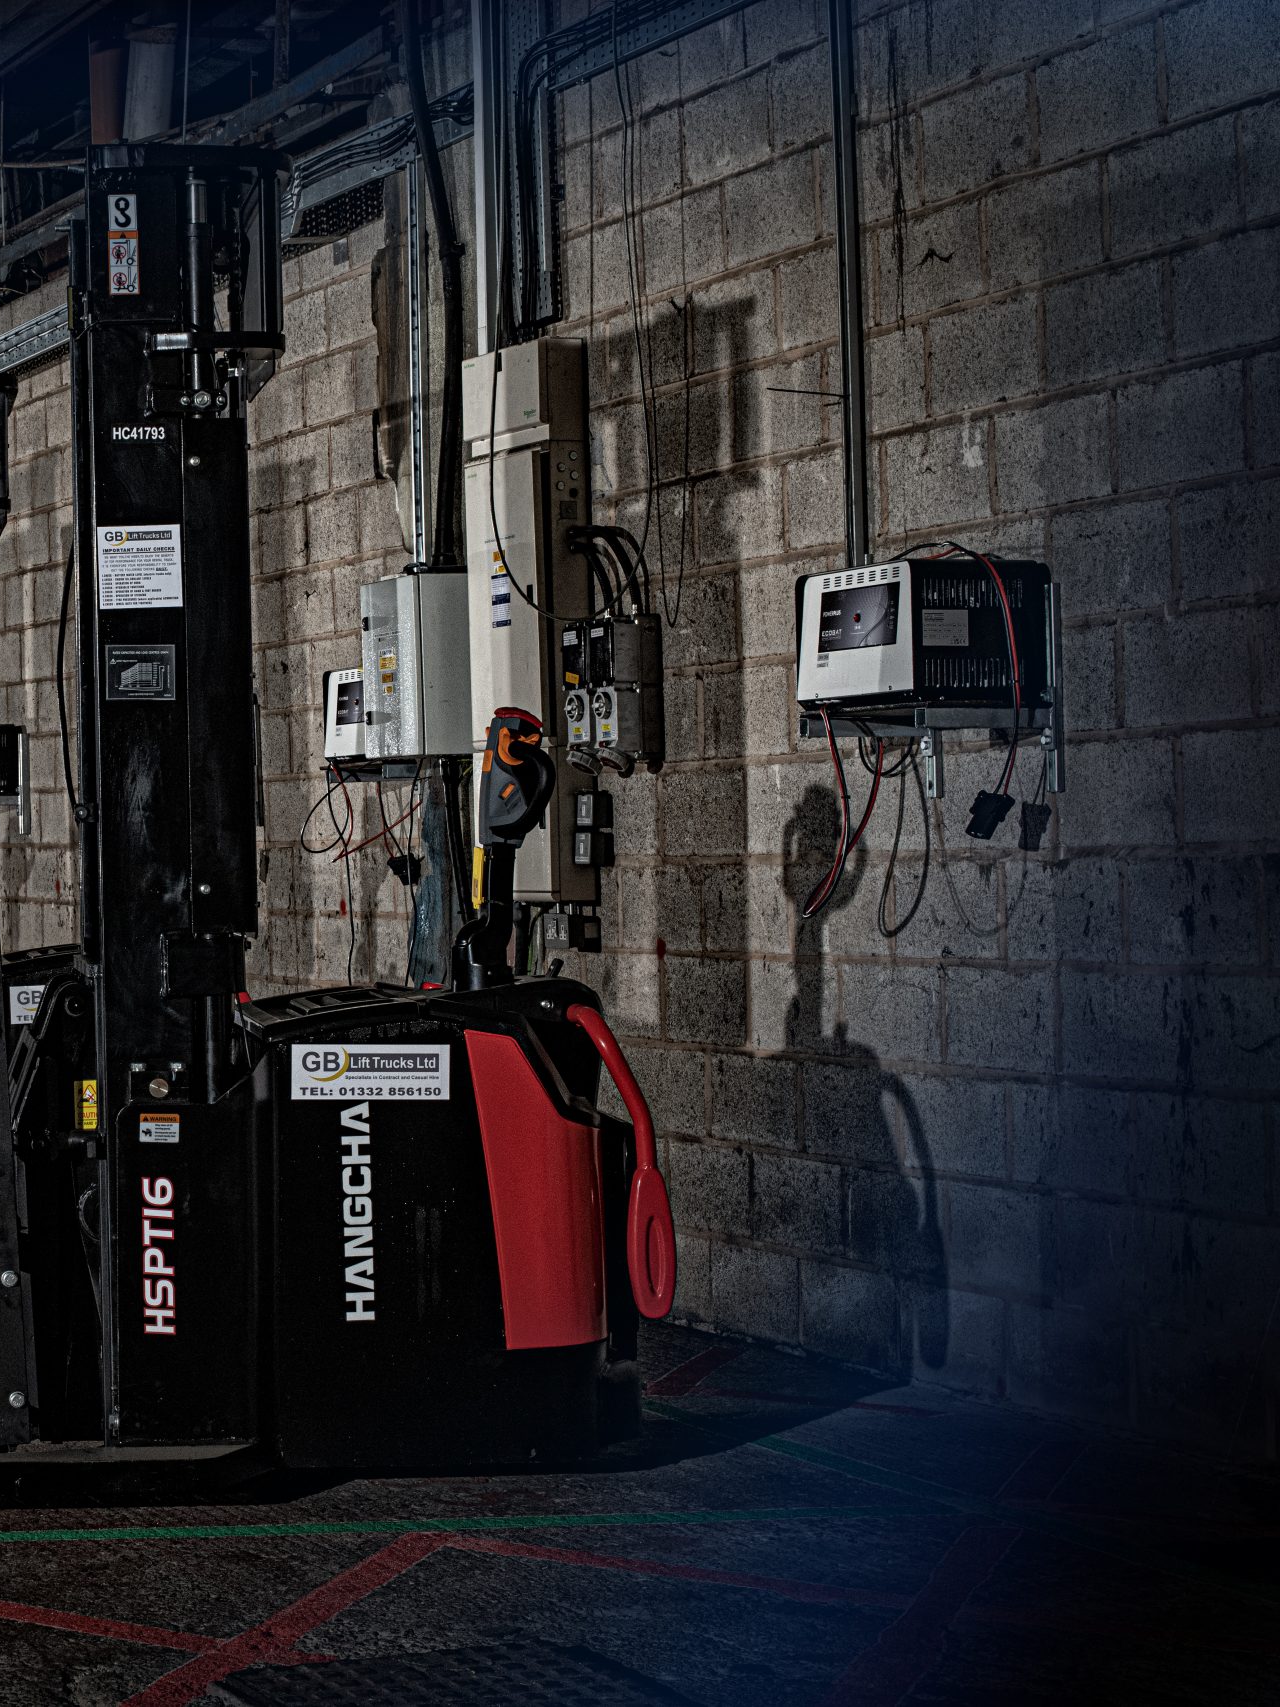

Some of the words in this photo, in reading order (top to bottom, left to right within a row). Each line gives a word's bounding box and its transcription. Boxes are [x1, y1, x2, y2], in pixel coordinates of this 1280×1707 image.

[112, 426, 166, 440] HC41793
[104, 531, 124, 542] GB
[128, 532, 139, 540] Lift
[139, 532, 160, 540] Trucks
[161, 531, 171, 539] Ltd
[16, 991, 42, 1005] GB
[301, 1051, 340, 1072] GB
[350, 1056, 370, 1069] Lift
[372, 1056, 414, 1069] Trucks
[416, 1056, 436, 1069] Ltd
[300, 1087, 333, 1096] TEL:
[339, 1087, 383, 1096] 01332
[388, 1087, 441, 1096] 856150
[339, 1100, 376, 1323] HANGCHA
